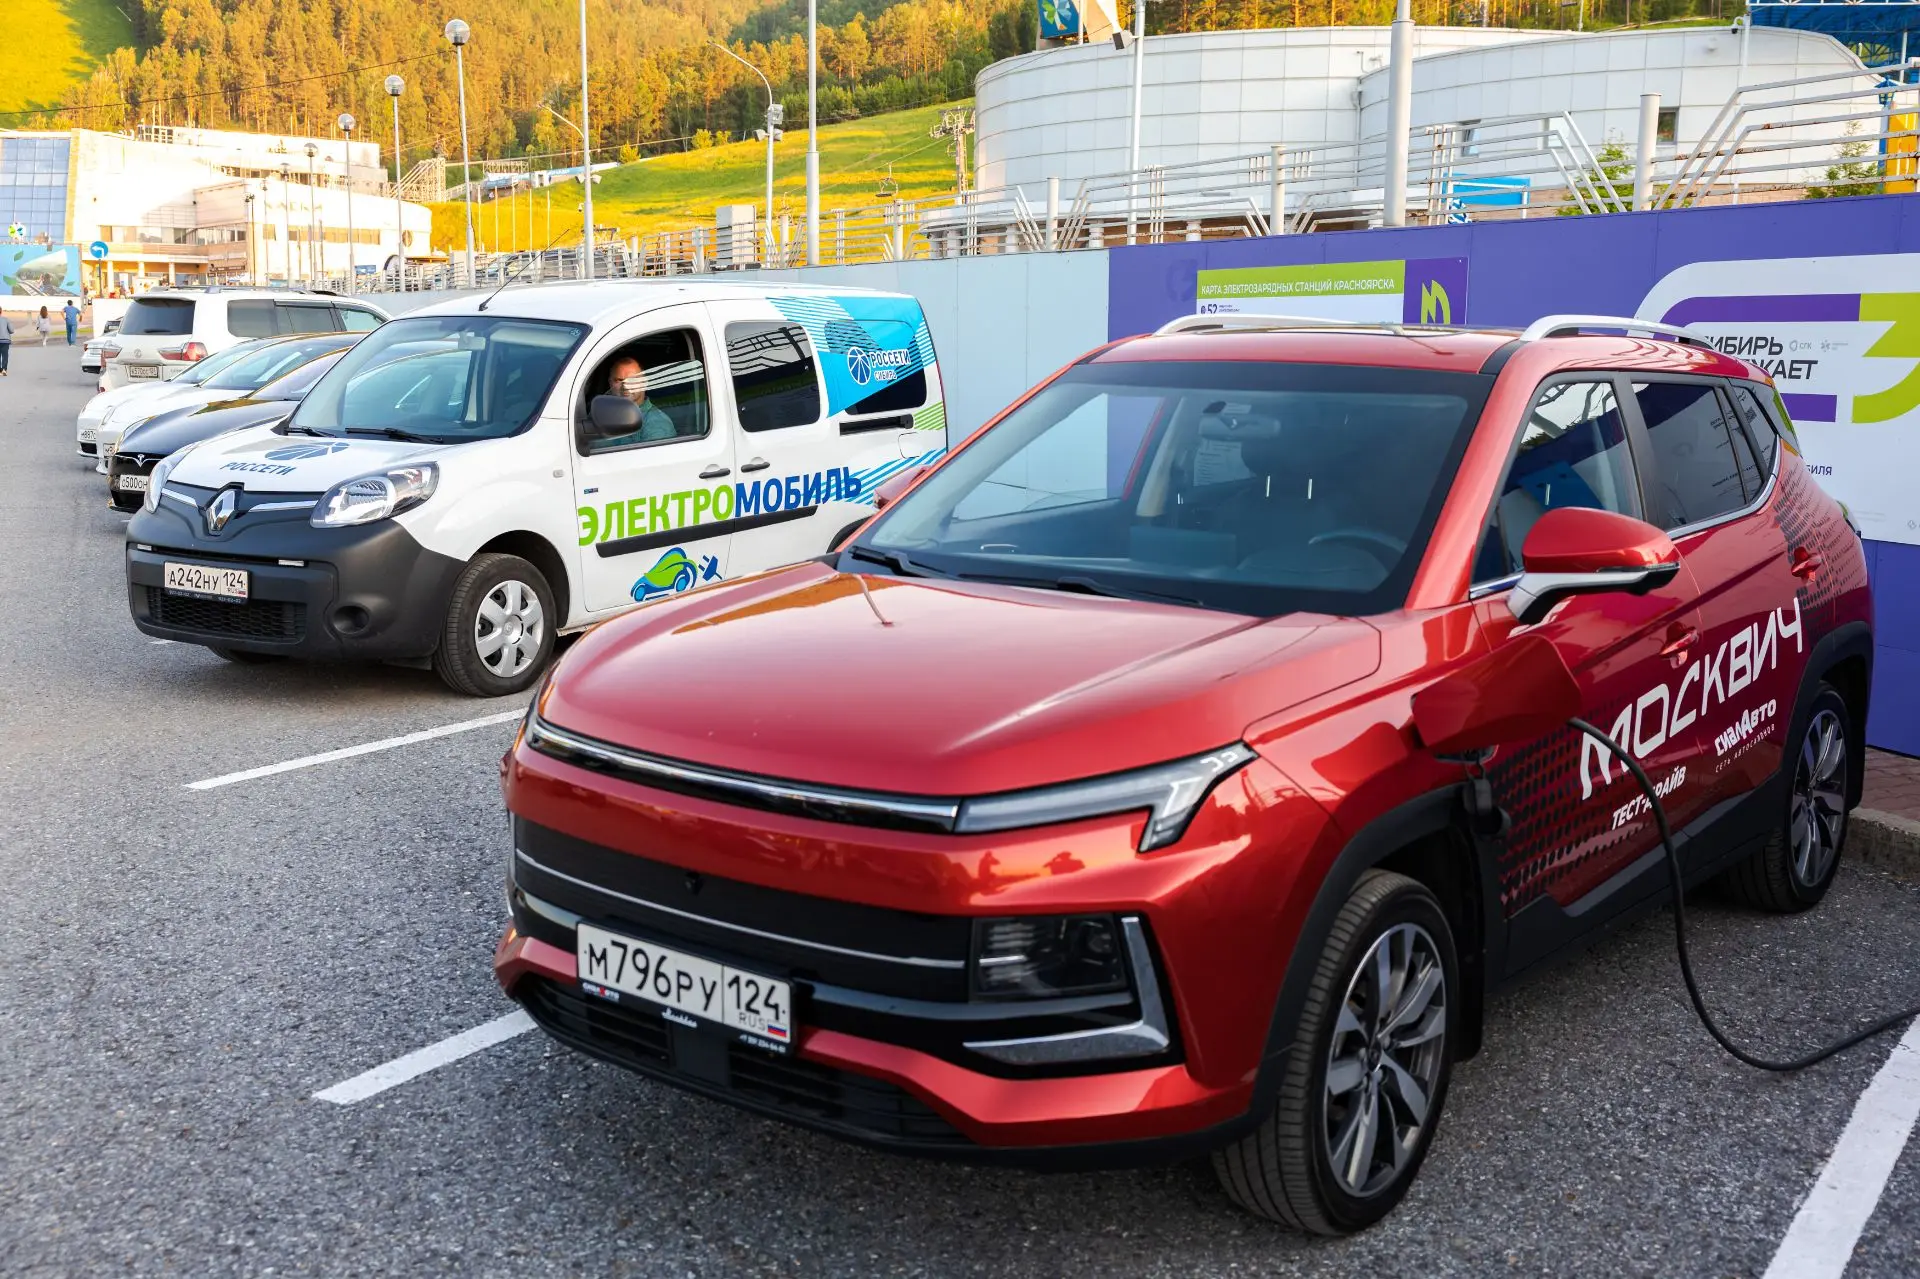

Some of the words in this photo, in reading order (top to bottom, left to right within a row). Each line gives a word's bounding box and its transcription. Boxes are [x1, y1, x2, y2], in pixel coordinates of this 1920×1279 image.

[1201, 285, 1222, 295] КАРТА
[1223, 282, 1293, 295] ЭЛЕКТРОЗАРЯДНЫХ
[1295, 279, 1332, 293] СТАНЦИЙ
[1334, 279, 1395, 291] КРАСНОЯРСКА
[1704, 336, 1784, 355] ИБИРЬ
[870, 349, 911, 367] РОССЕТИ
[874, 370, 897, 380] СИБИРЬ
[219, 462, 297, 475] РОССЕТИ
[578, 466, 862, 547] ЭЛЕКТРОМОБИЛЬ
[169, 567, 219, 591] А242НУ
[222, 571, 243, 588] 124
[1580, 597, 1803, 801] МОСКВИЧ
[588, 940, 717, 1012] М796РУ
[727, 975, 780, 1021] 124
[739, 1011, 766, 1032] RUS
